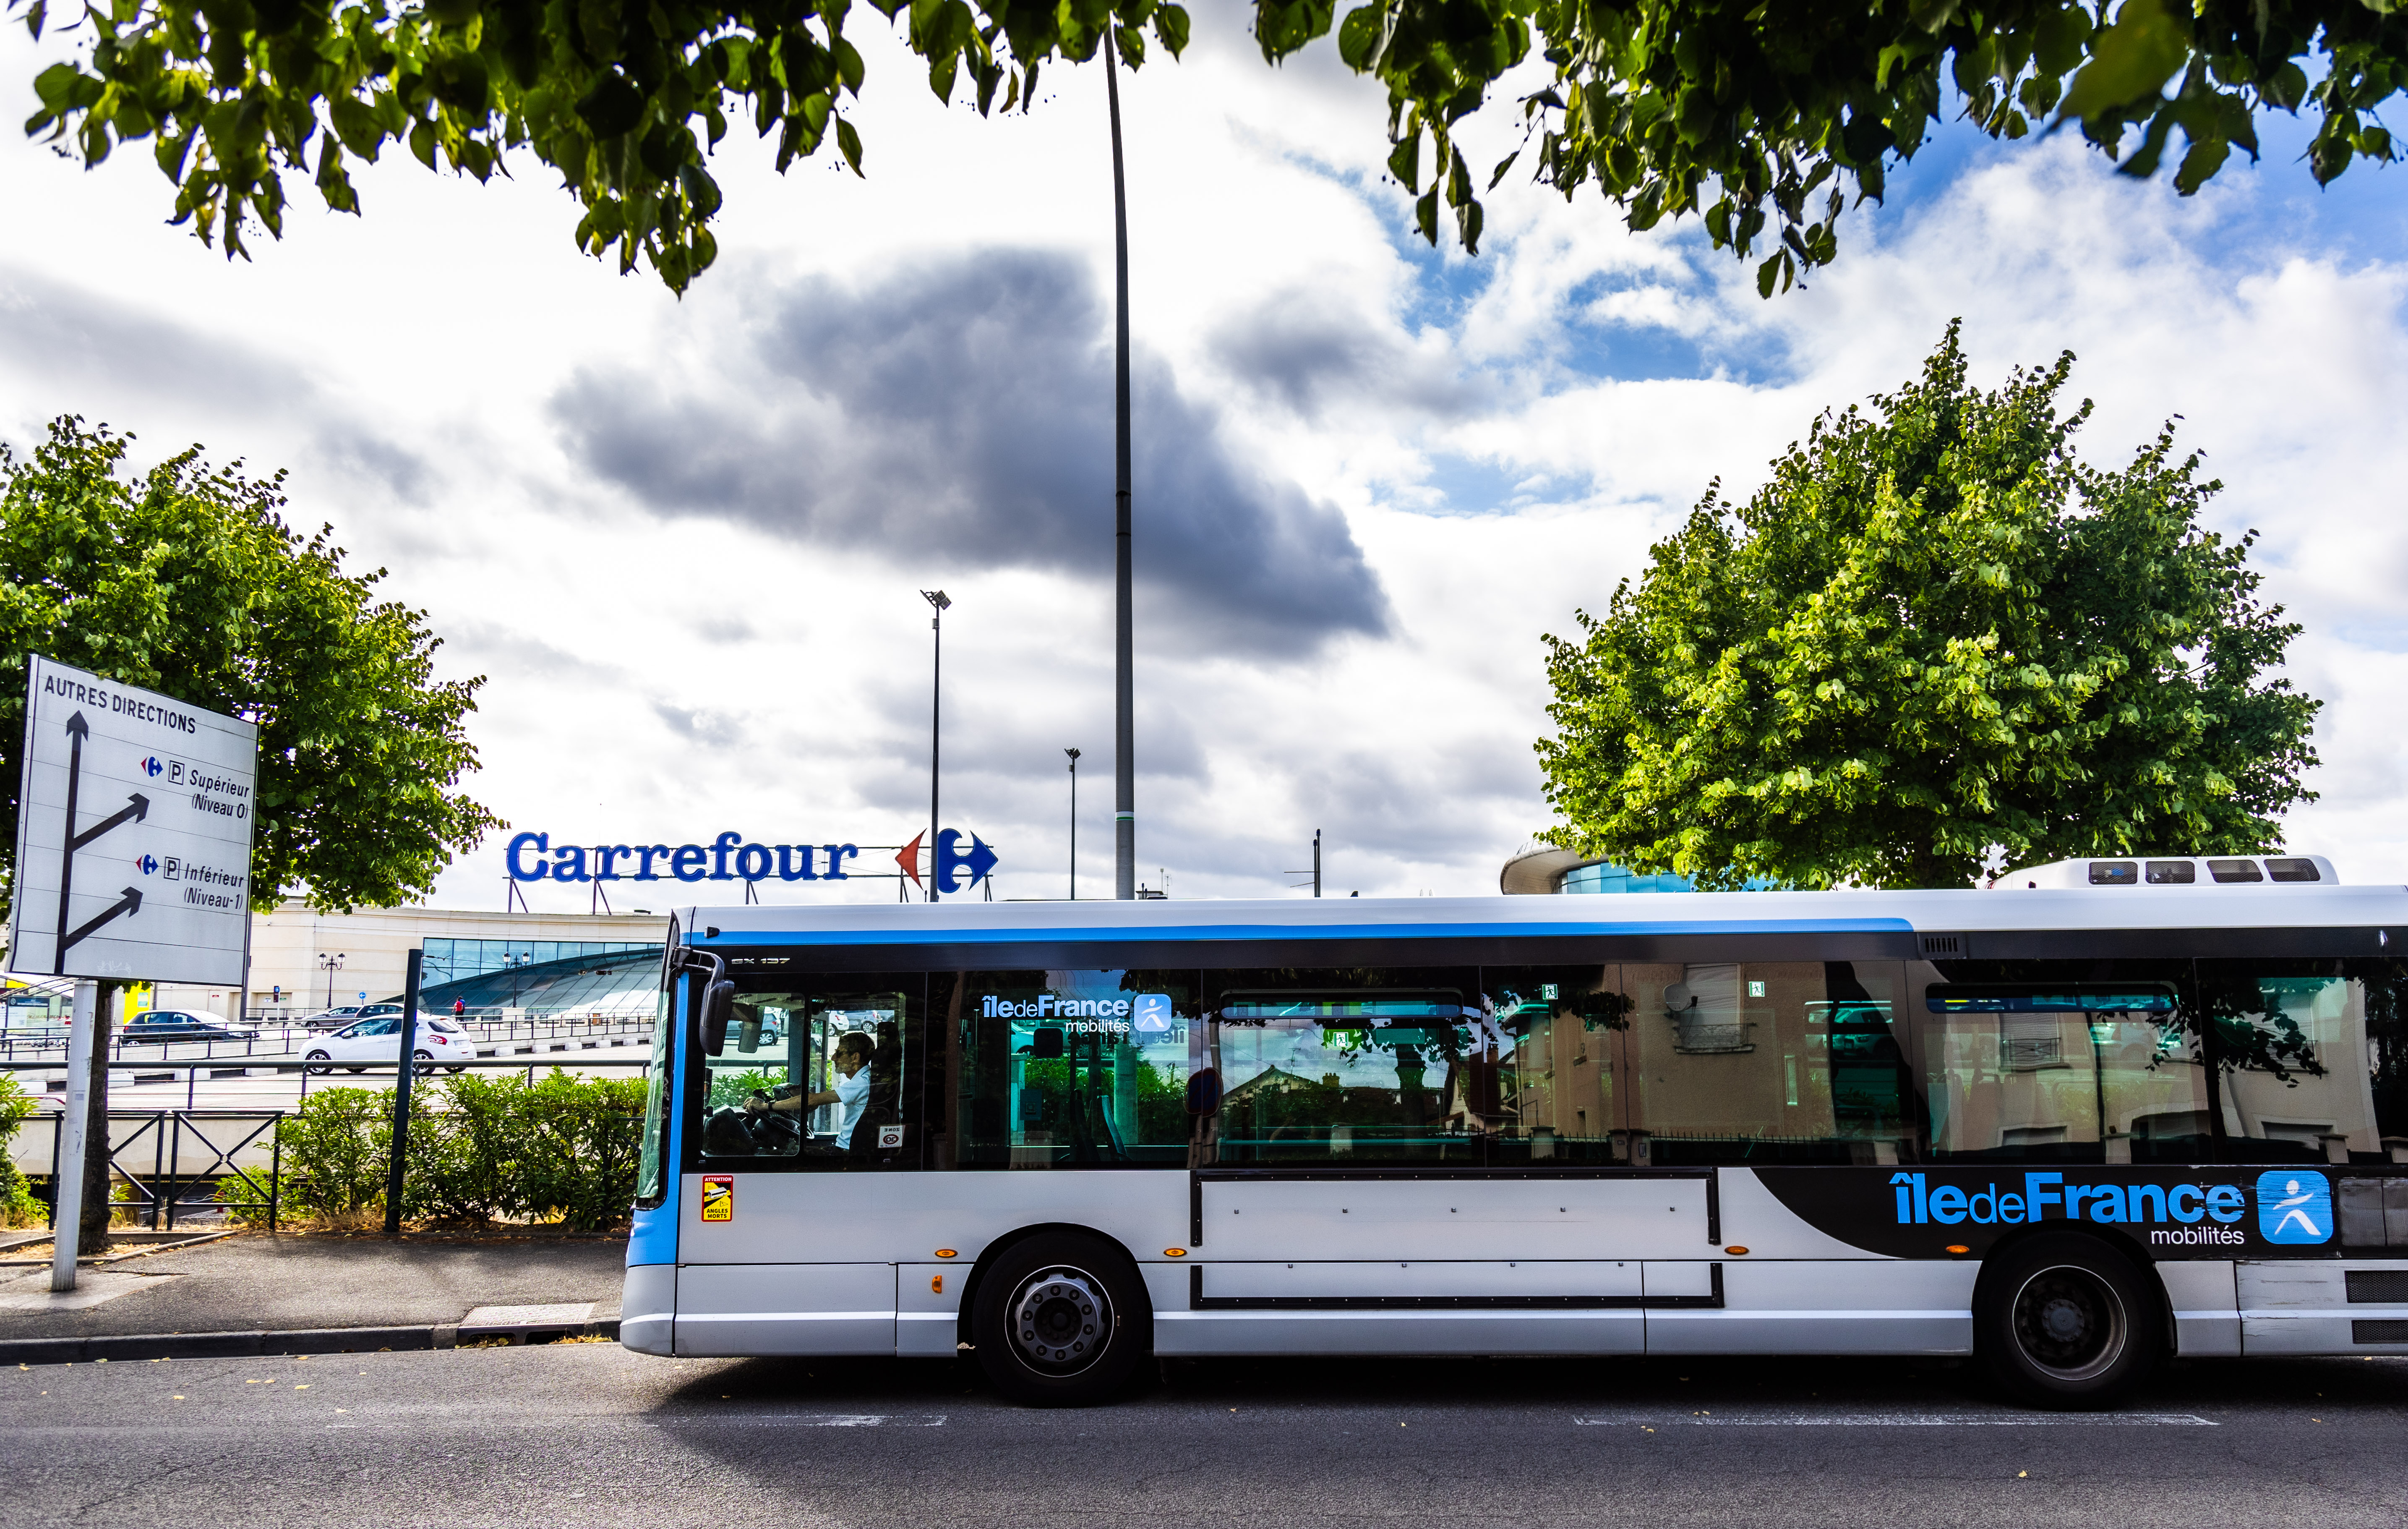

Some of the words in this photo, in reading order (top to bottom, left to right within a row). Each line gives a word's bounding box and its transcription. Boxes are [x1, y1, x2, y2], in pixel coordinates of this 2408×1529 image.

[44, 675, 107, 708] AUTRES
[112, 694, 196, 734] DIRECTIONS
[171, 763, 181, 780] P
[190, 769, 249, 797] Supérieur
[192, 793, 234, 816] (Niveau
[237, 803, 248, 819] 0)
[506, 831, 858, 883] Carrefour
[167, 860, 177, 876] P
[185, 863, 244, 887] Inférieur
[1065, 1018, 1130, 1032] mobilités
[2151, 1226, 2244, 1245] mobilités
